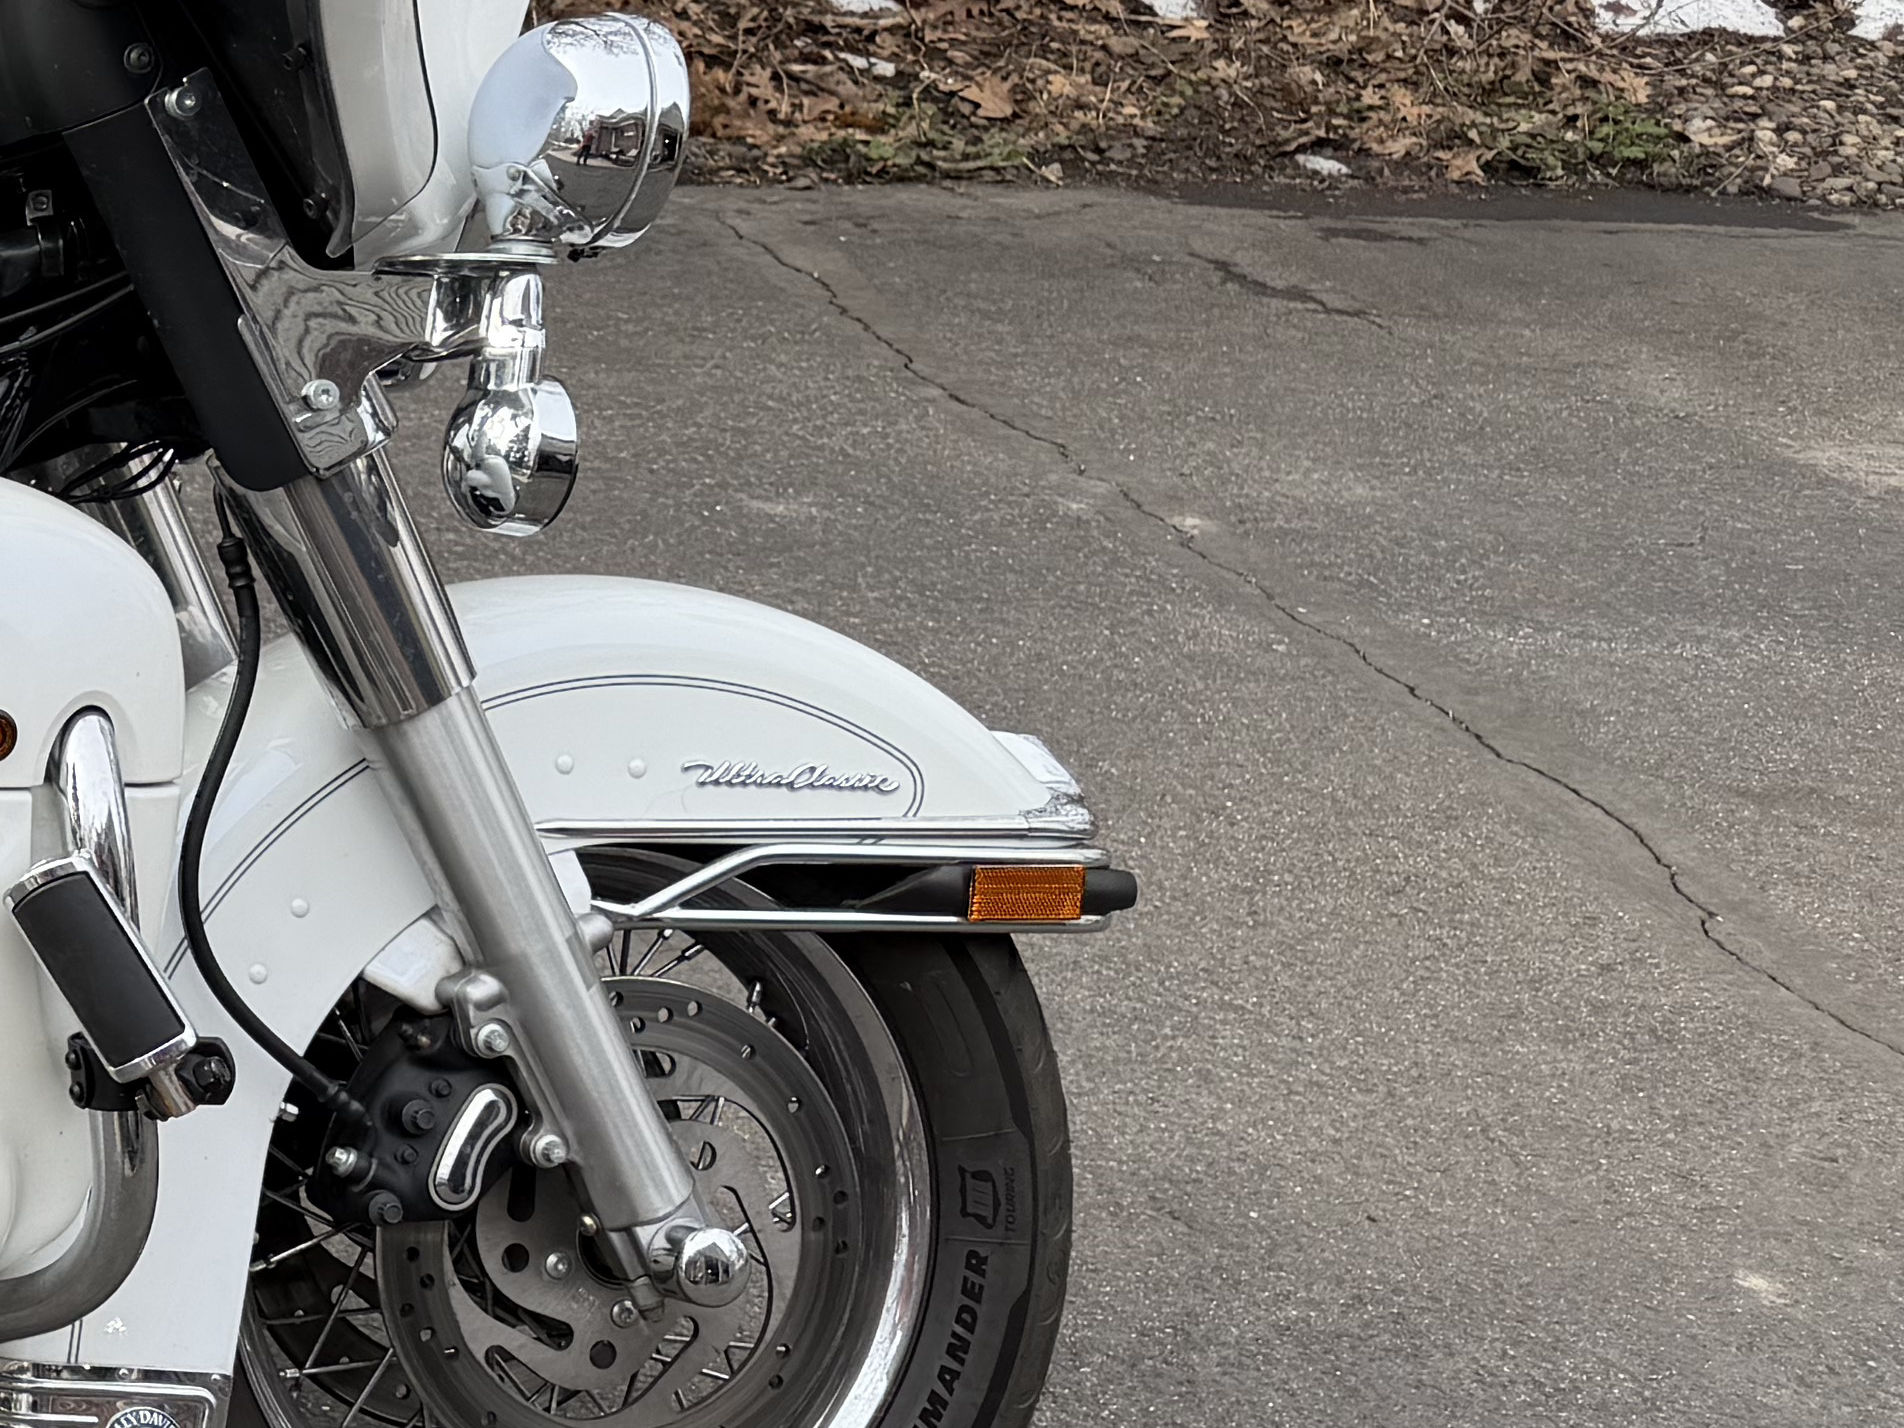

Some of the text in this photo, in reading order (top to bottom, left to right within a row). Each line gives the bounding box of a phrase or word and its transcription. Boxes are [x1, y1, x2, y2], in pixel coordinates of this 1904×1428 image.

[680, 759, 901, 794] Ultra Classic
[1003, 1165, 1017, 1234] TOURING
